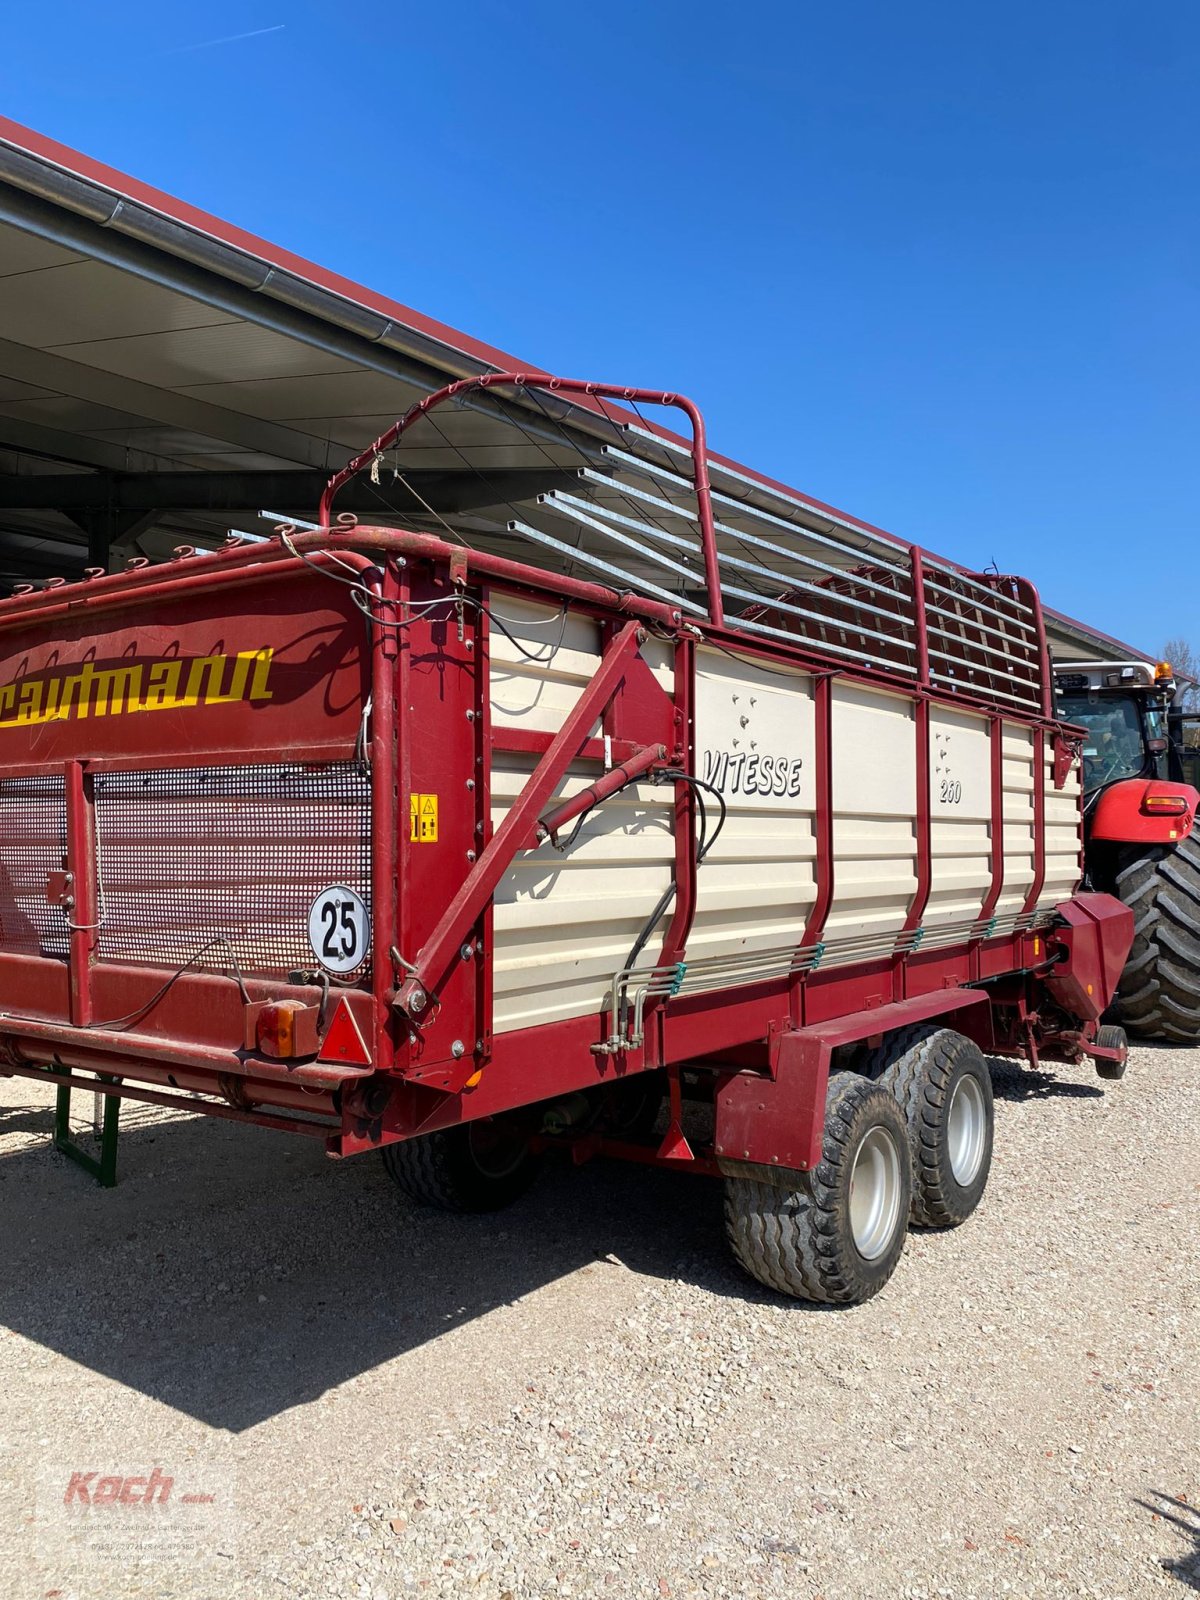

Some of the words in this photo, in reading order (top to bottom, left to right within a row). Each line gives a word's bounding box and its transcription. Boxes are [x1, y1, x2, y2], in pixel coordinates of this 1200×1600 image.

[702, 749, 803, 798] VITESSE
[939, 779, 962, 804] 260
[321, 901, 357, 958] 25
